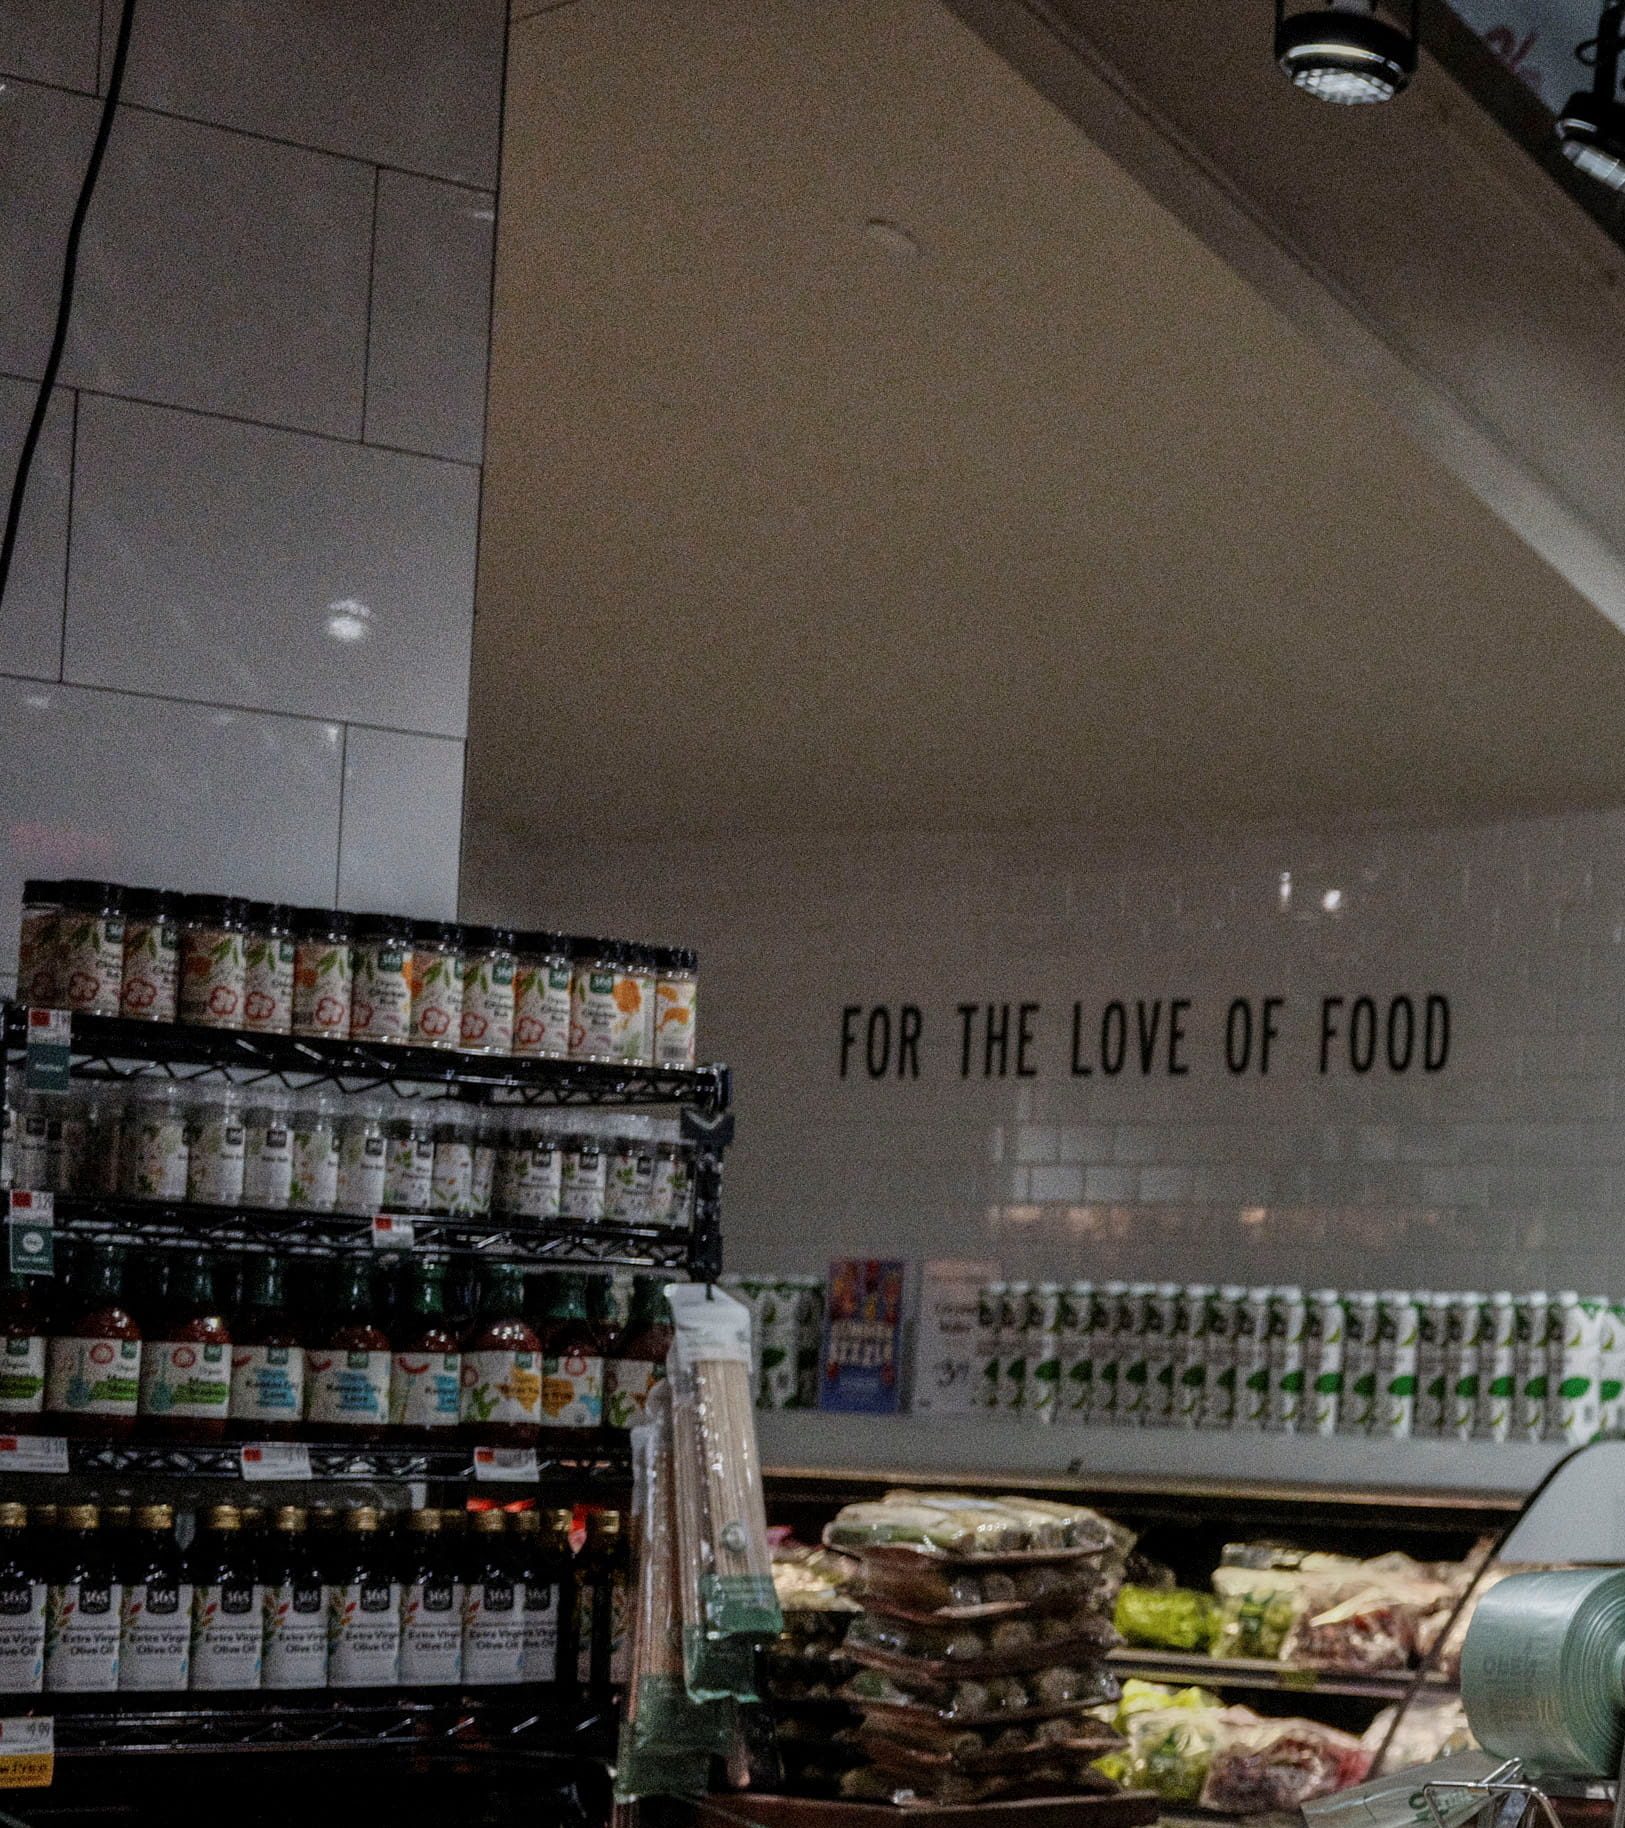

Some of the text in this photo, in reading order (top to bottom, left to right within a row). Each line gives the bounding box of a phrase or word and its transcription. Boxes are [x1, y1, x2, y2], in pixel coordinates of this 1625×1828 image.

[839, 995, 1452, 1078] FOR THE LOVE OF FOOD
